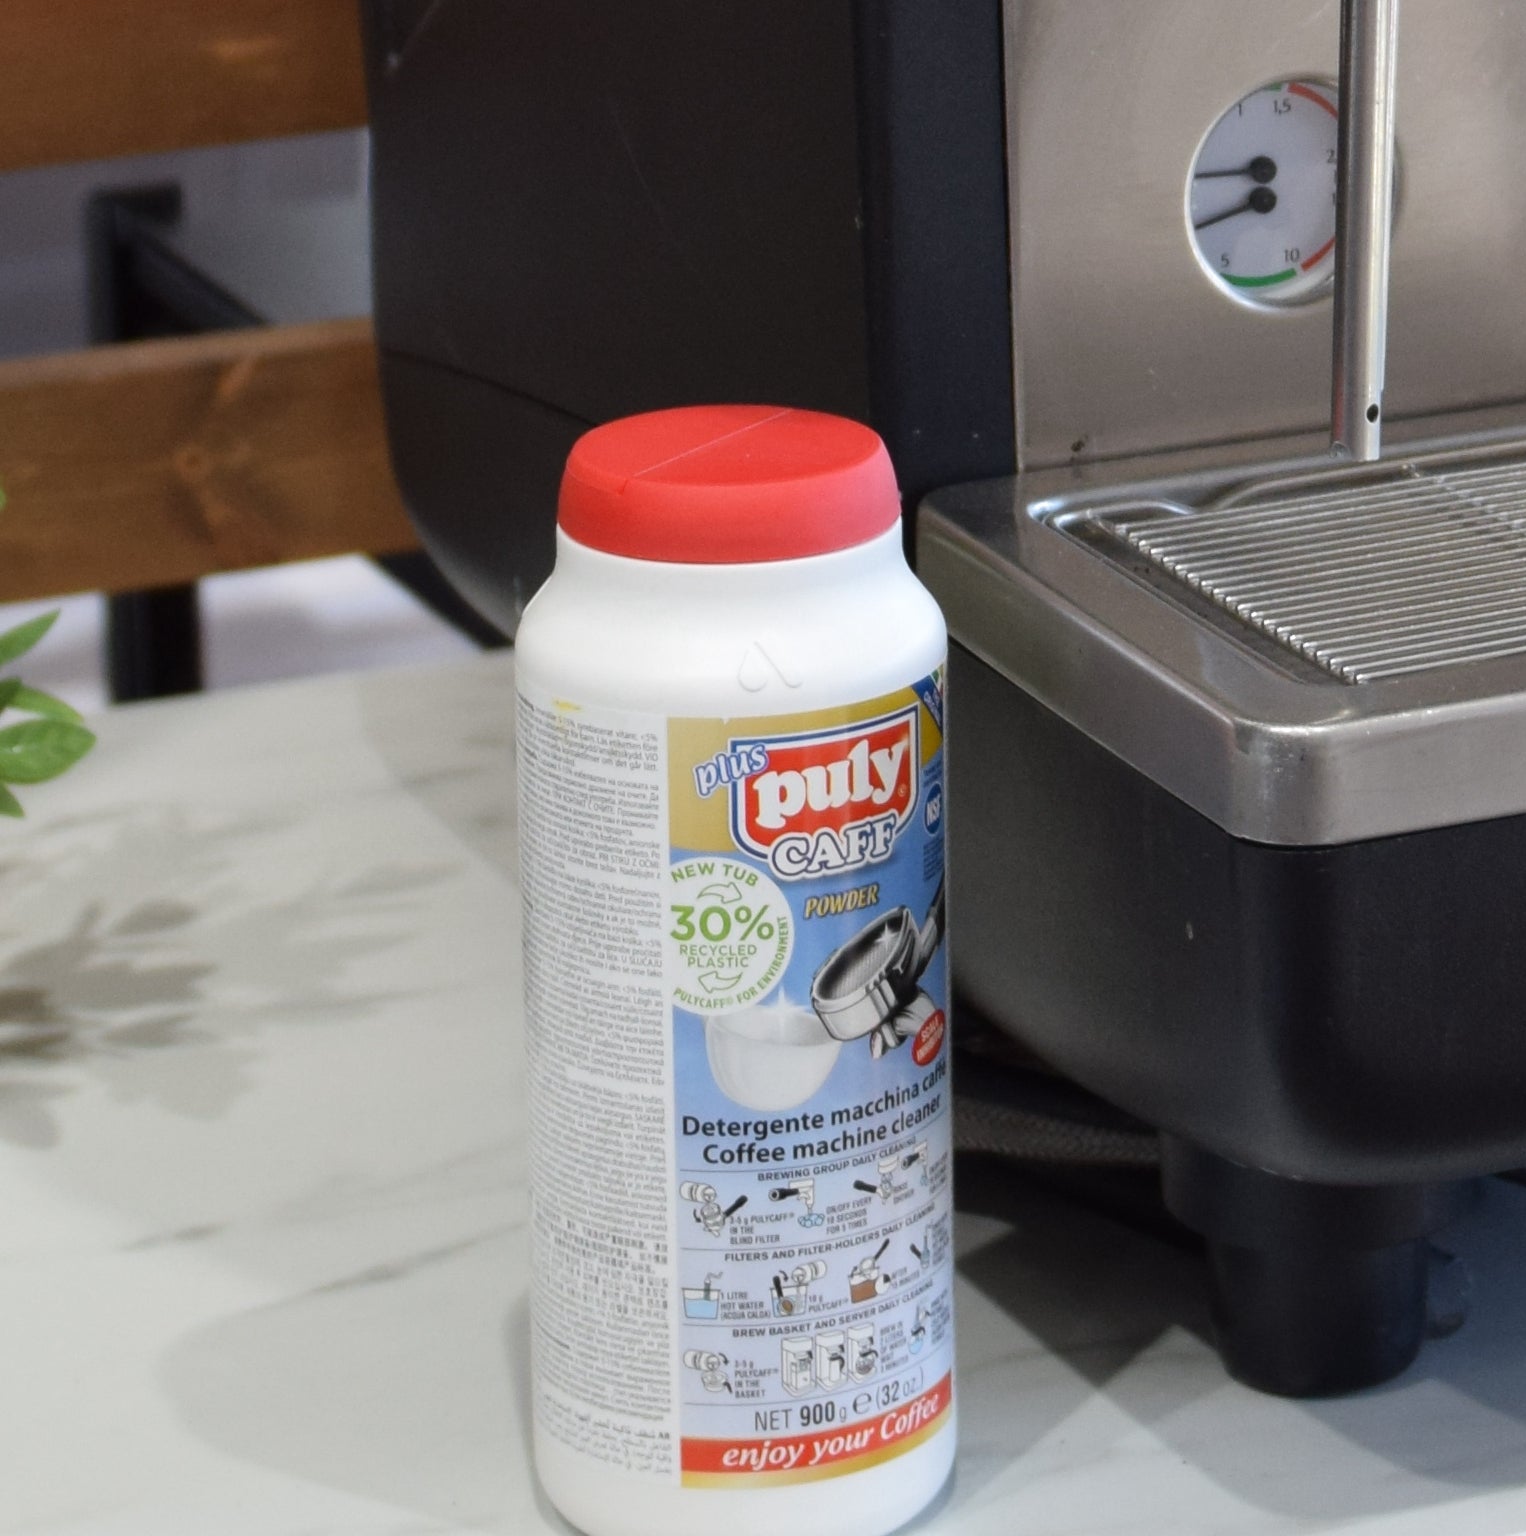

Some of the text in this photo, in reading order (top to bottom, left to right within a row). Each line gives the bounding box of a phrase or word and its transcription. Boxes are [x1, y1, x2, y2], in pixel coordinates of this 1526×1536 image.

[1273, 99, 1291, 115] 1,5
[1221, 249, 1300, 267] 5 10
[693, 743, 769, 799] plus
[753, 738, 909, 829] puly
[771, 812, 897, 877] CAFF
[670, 863, 759, 887] NEW TUB
[804, 883, 880, 920] POWDER
[670, 904, 775, 942] 30%
[680, 944, 757, 956] RECYCLED
[687, 957, 749, 968] PLASTIC
[736, 987, 758, 1004] FOR
[757, 916, 789, 990] ENVIRONMENT
[682, 1114, 824, 1141] Detergente
[831, 1083, 919, 1126] macchina
[703, 1092, 941, 1164] Coffee machine cleaner
[757, 1168, 811, 1182] BREWING
[813, 1161, 849, 1176] GROUP
[852, 1153, 876, 1167] DAILY
[724, 1251, 769, 1262] FILTERS
[772, 1249, 796, 1259] AND
[798, 1231, 880, 1257] FILTER-HOLDERS
[882, 1223, 903, 1236] DAILY
[755, 1234, 780, 1244] FILTER
[733, 1328, 766, 1338] BREW
[769, 1323, 811, 1335] BASKET
[814, 1319, 836, 1330] AND
[839, 1307, 876, 1325] SERVER
[878, 1299, 899, 1314] DAILY
[735, 1389, 765, 1398] BASKET
[755, 1408, 792, 1431] NET
[800, 1401, 835, 1427] 900
[839, 1407, 847, 1423] g
[875, 1380, 899, 1410] (32
[722, 1393, 940, 1470] enjoy your Coffee
